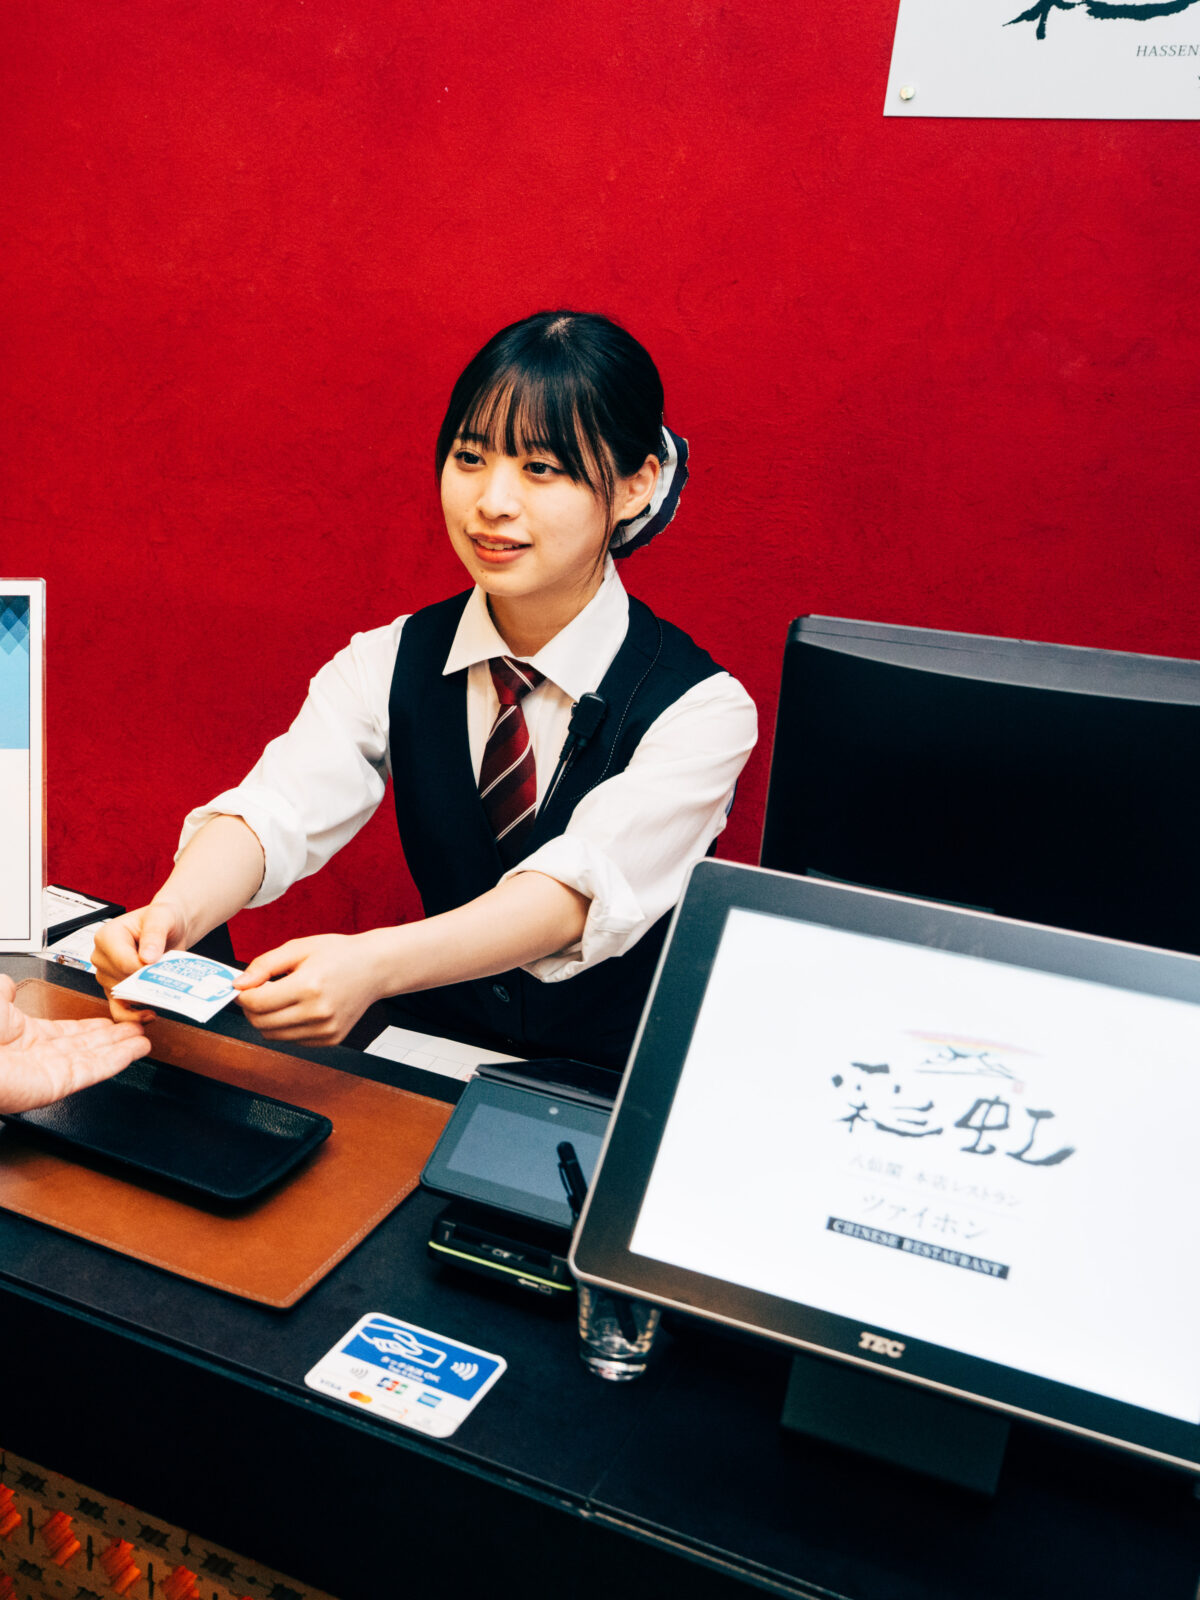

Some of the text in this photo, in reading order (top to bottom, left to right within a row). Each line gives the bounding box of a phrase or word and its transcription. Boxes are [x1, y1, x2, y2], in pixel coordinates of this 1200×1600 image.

[1136, 45, 1200, 57] HASSEN
[832, 1219, 1003, 1275] CHINESE RESTAURANT
[858, 1331, 906, 1358] TEC
